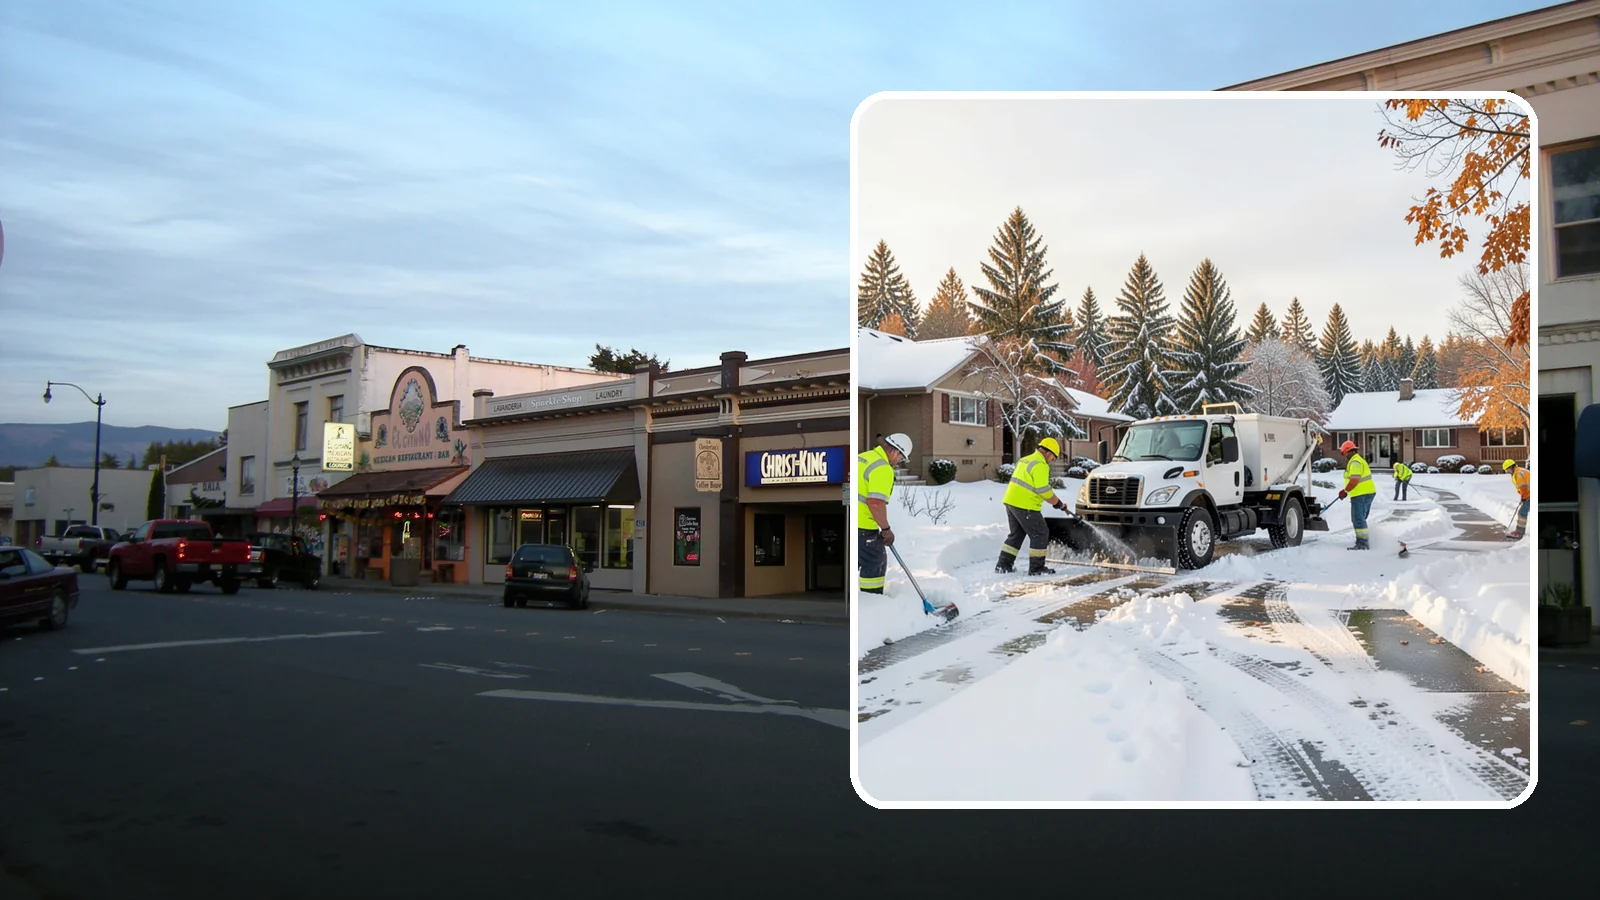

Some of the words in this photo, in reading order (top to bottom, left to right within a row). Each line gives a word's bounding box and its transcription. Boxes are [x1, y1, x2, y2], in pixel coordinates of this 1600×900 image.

[493, 402, 523, 413] LAVANDERIA
[530, 396, 561, 409] Sparkle
[561, 394, 583, 406] Shop
[595, 389, 624, 400] LAUNDRY
[373, 455, 396, 464] MEXICAN
[397, 451, 433, 462] RESTAURANT
[438, 450, 450, 459] BAR
[760, 452, 796, 478] CHRIST
[799, 449, 828, 476] KING
